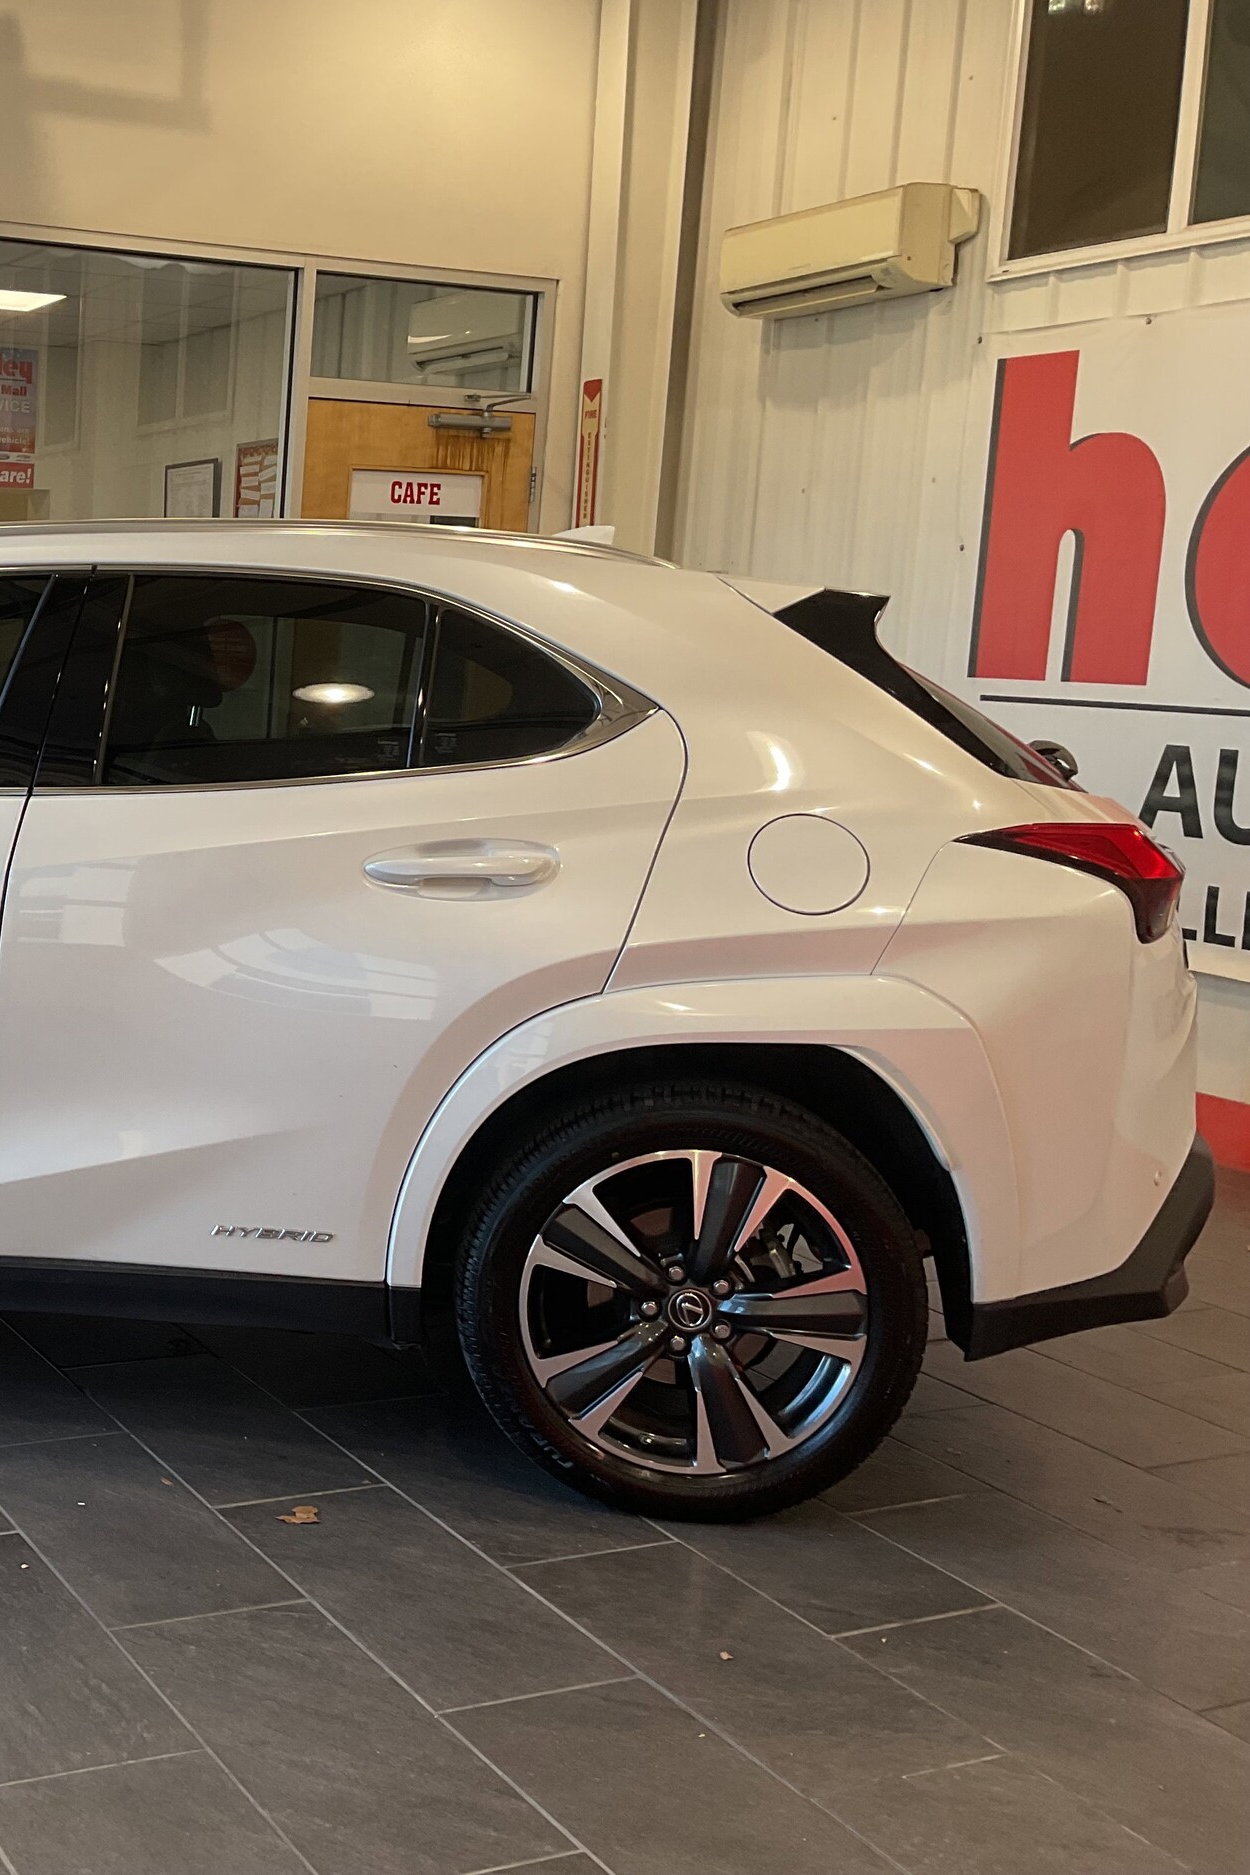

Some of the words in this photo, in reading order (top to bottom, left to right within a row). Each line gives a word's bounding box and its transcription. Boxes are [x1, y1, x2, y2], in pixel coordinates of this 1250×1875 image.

[1, 385, 27, 396] Mall
[584, 409, 598, 419] FIRE
[582, 432, 592, 519] EXTINGUISHER
[391, 481, 441, 505] CAFE
[210, 1224, 334, 1243] HYBRID
